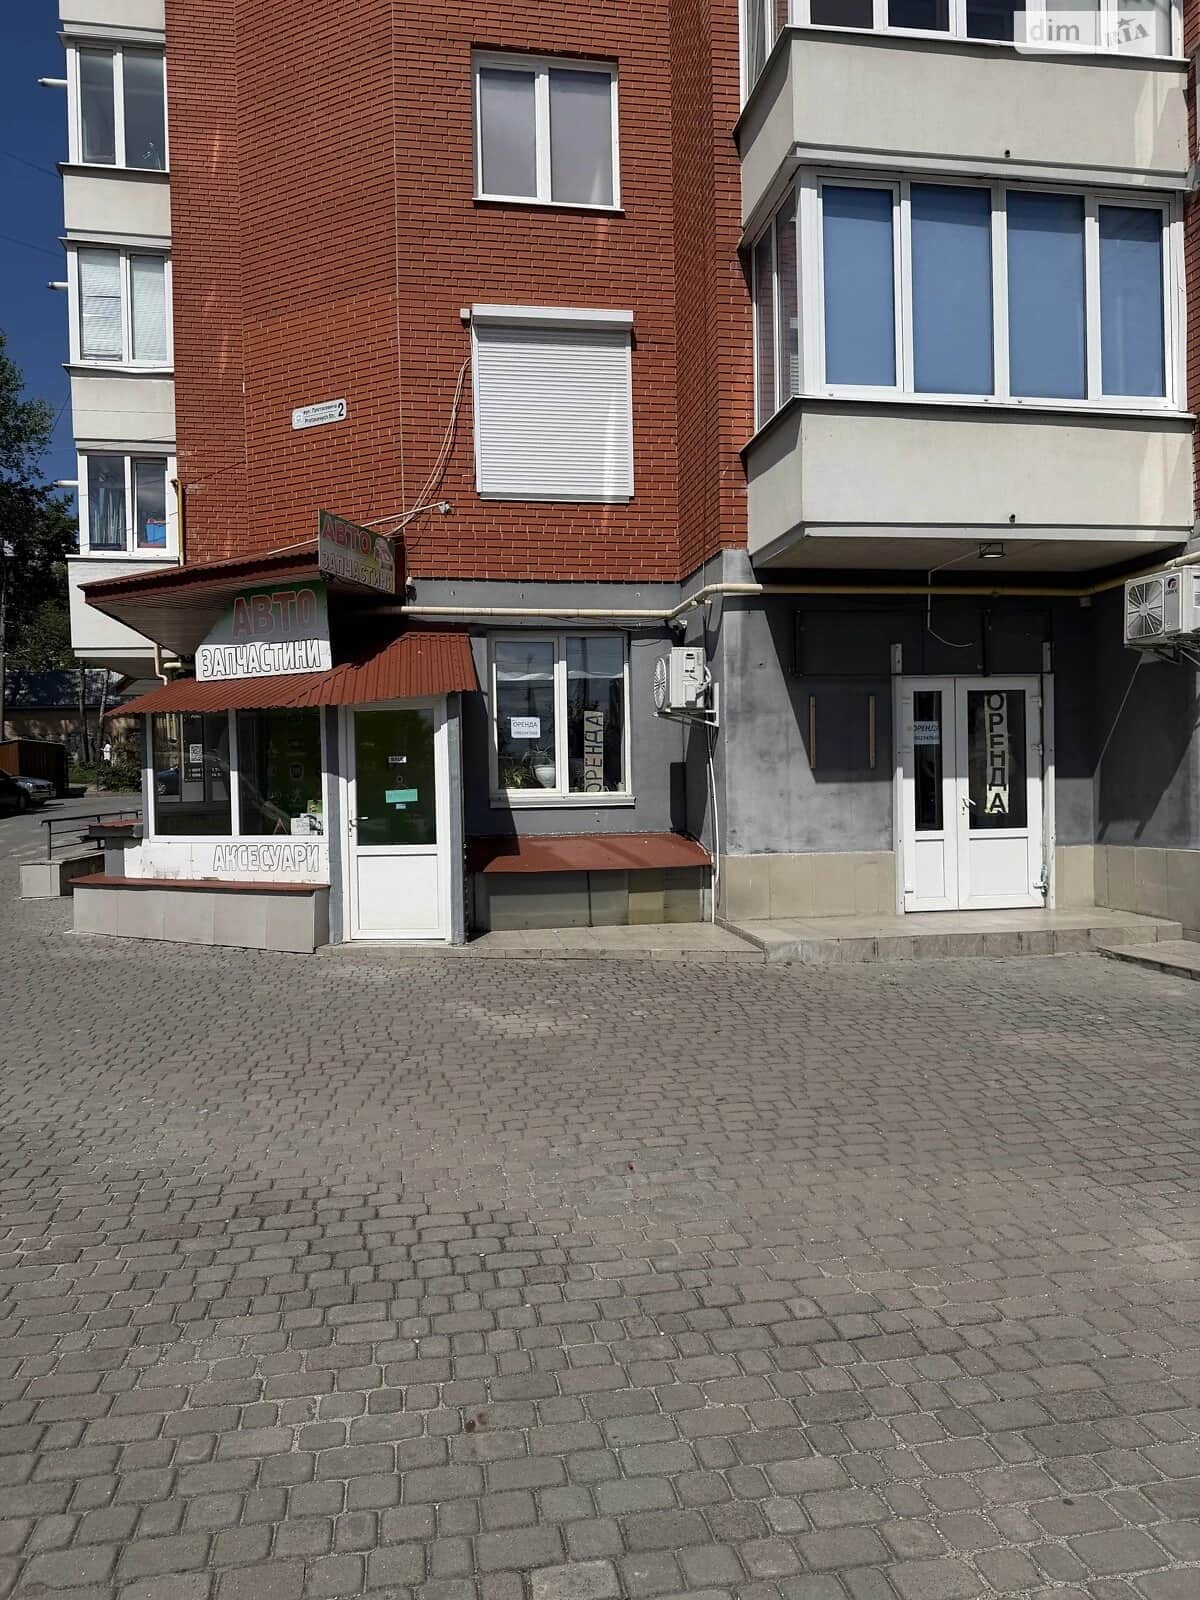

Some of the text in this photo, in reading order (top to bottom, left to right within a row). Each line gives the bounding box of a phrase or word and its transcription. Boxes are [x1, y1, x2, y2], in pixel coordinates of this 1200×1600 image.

[338, 402, 344, 417] 2
[321, 515, 371, 554] АВТО
[321, 552, 393, 593] ЗАПЧАСТИНИ
[232, 588, 317, 640] АВТО
[201, 638, 321, 678] ЗАПЧАСТИНИ
[513, 721, 538, 729] ОРЕНДА
[585, 715, 603, 792] ОРЕНДА
[988, 693, 1007, 812] ОРЕНДА
[213, 844, 320, 873] АКСЕСУАРИ
